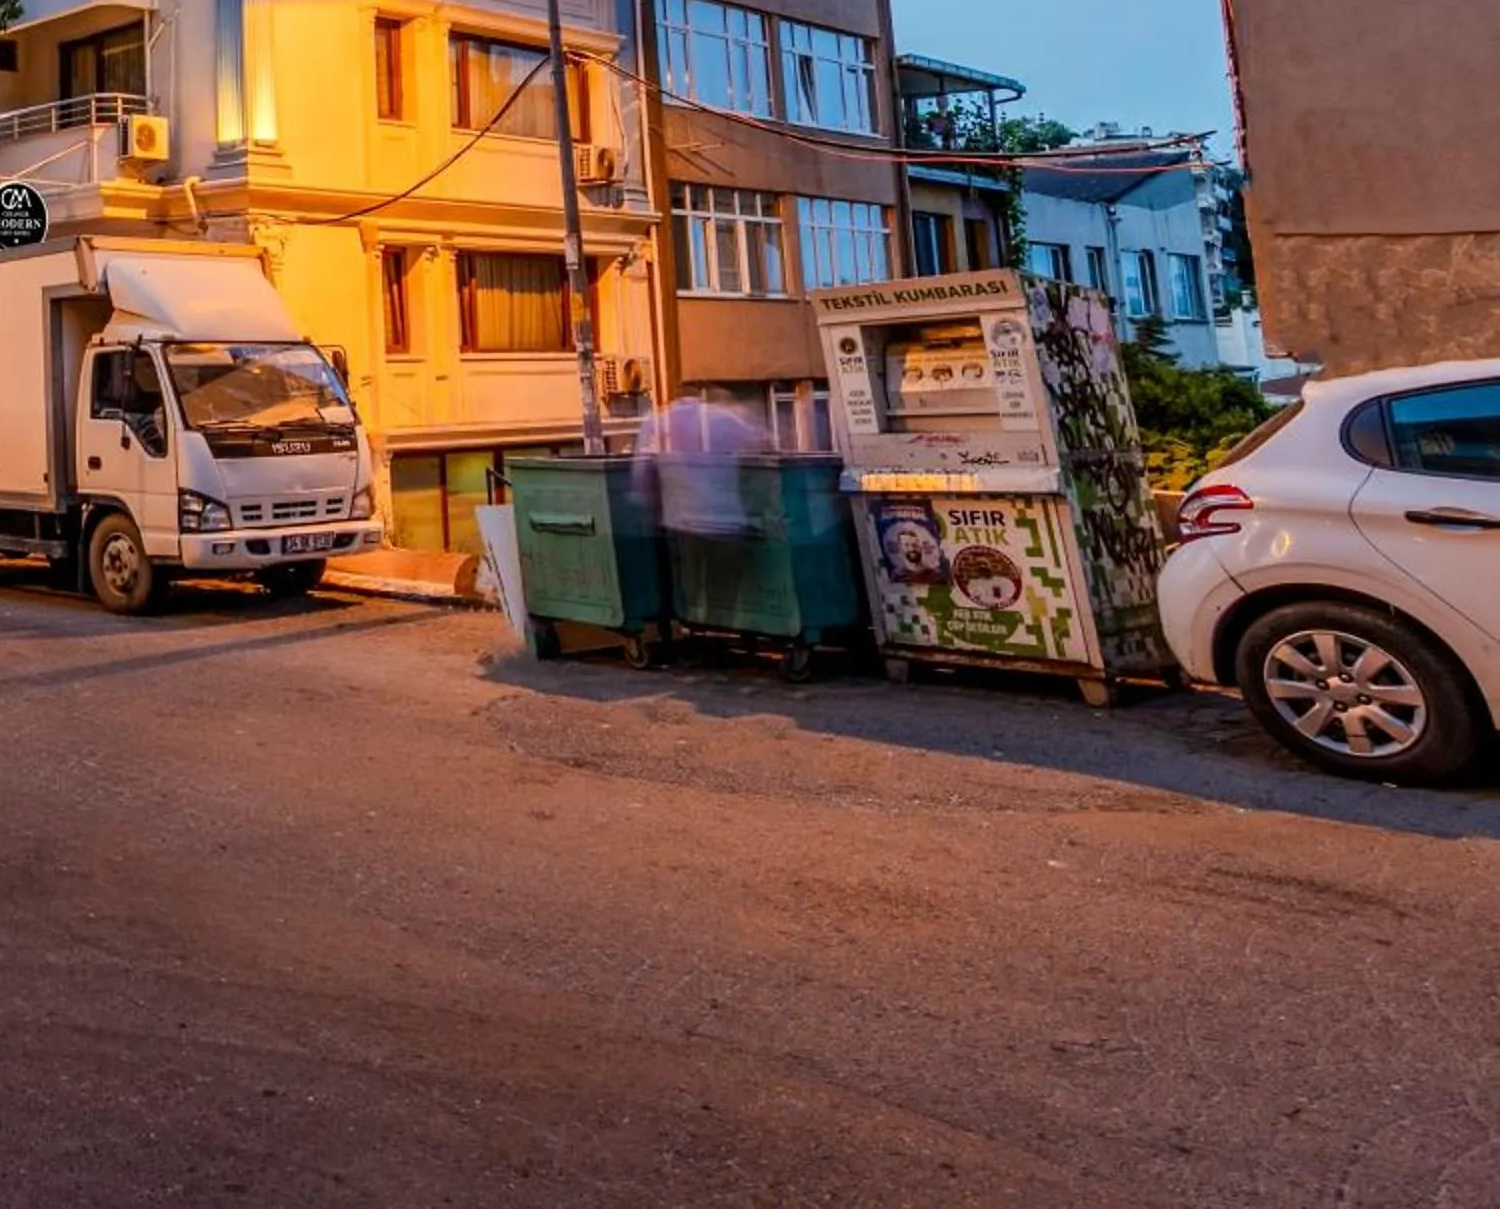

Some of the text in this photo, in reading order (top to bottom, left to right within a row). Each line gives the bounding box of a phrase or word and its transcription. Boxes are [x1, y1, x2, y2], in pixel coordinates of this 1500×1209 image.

[820, 279, 1008, 312] TEKSTİL KUMBARASI
[271, 442, 311, 454] ISUZU
[948, 509, 1006, 527] SIFIR
[954, 526, 1009, 545] ATIK
